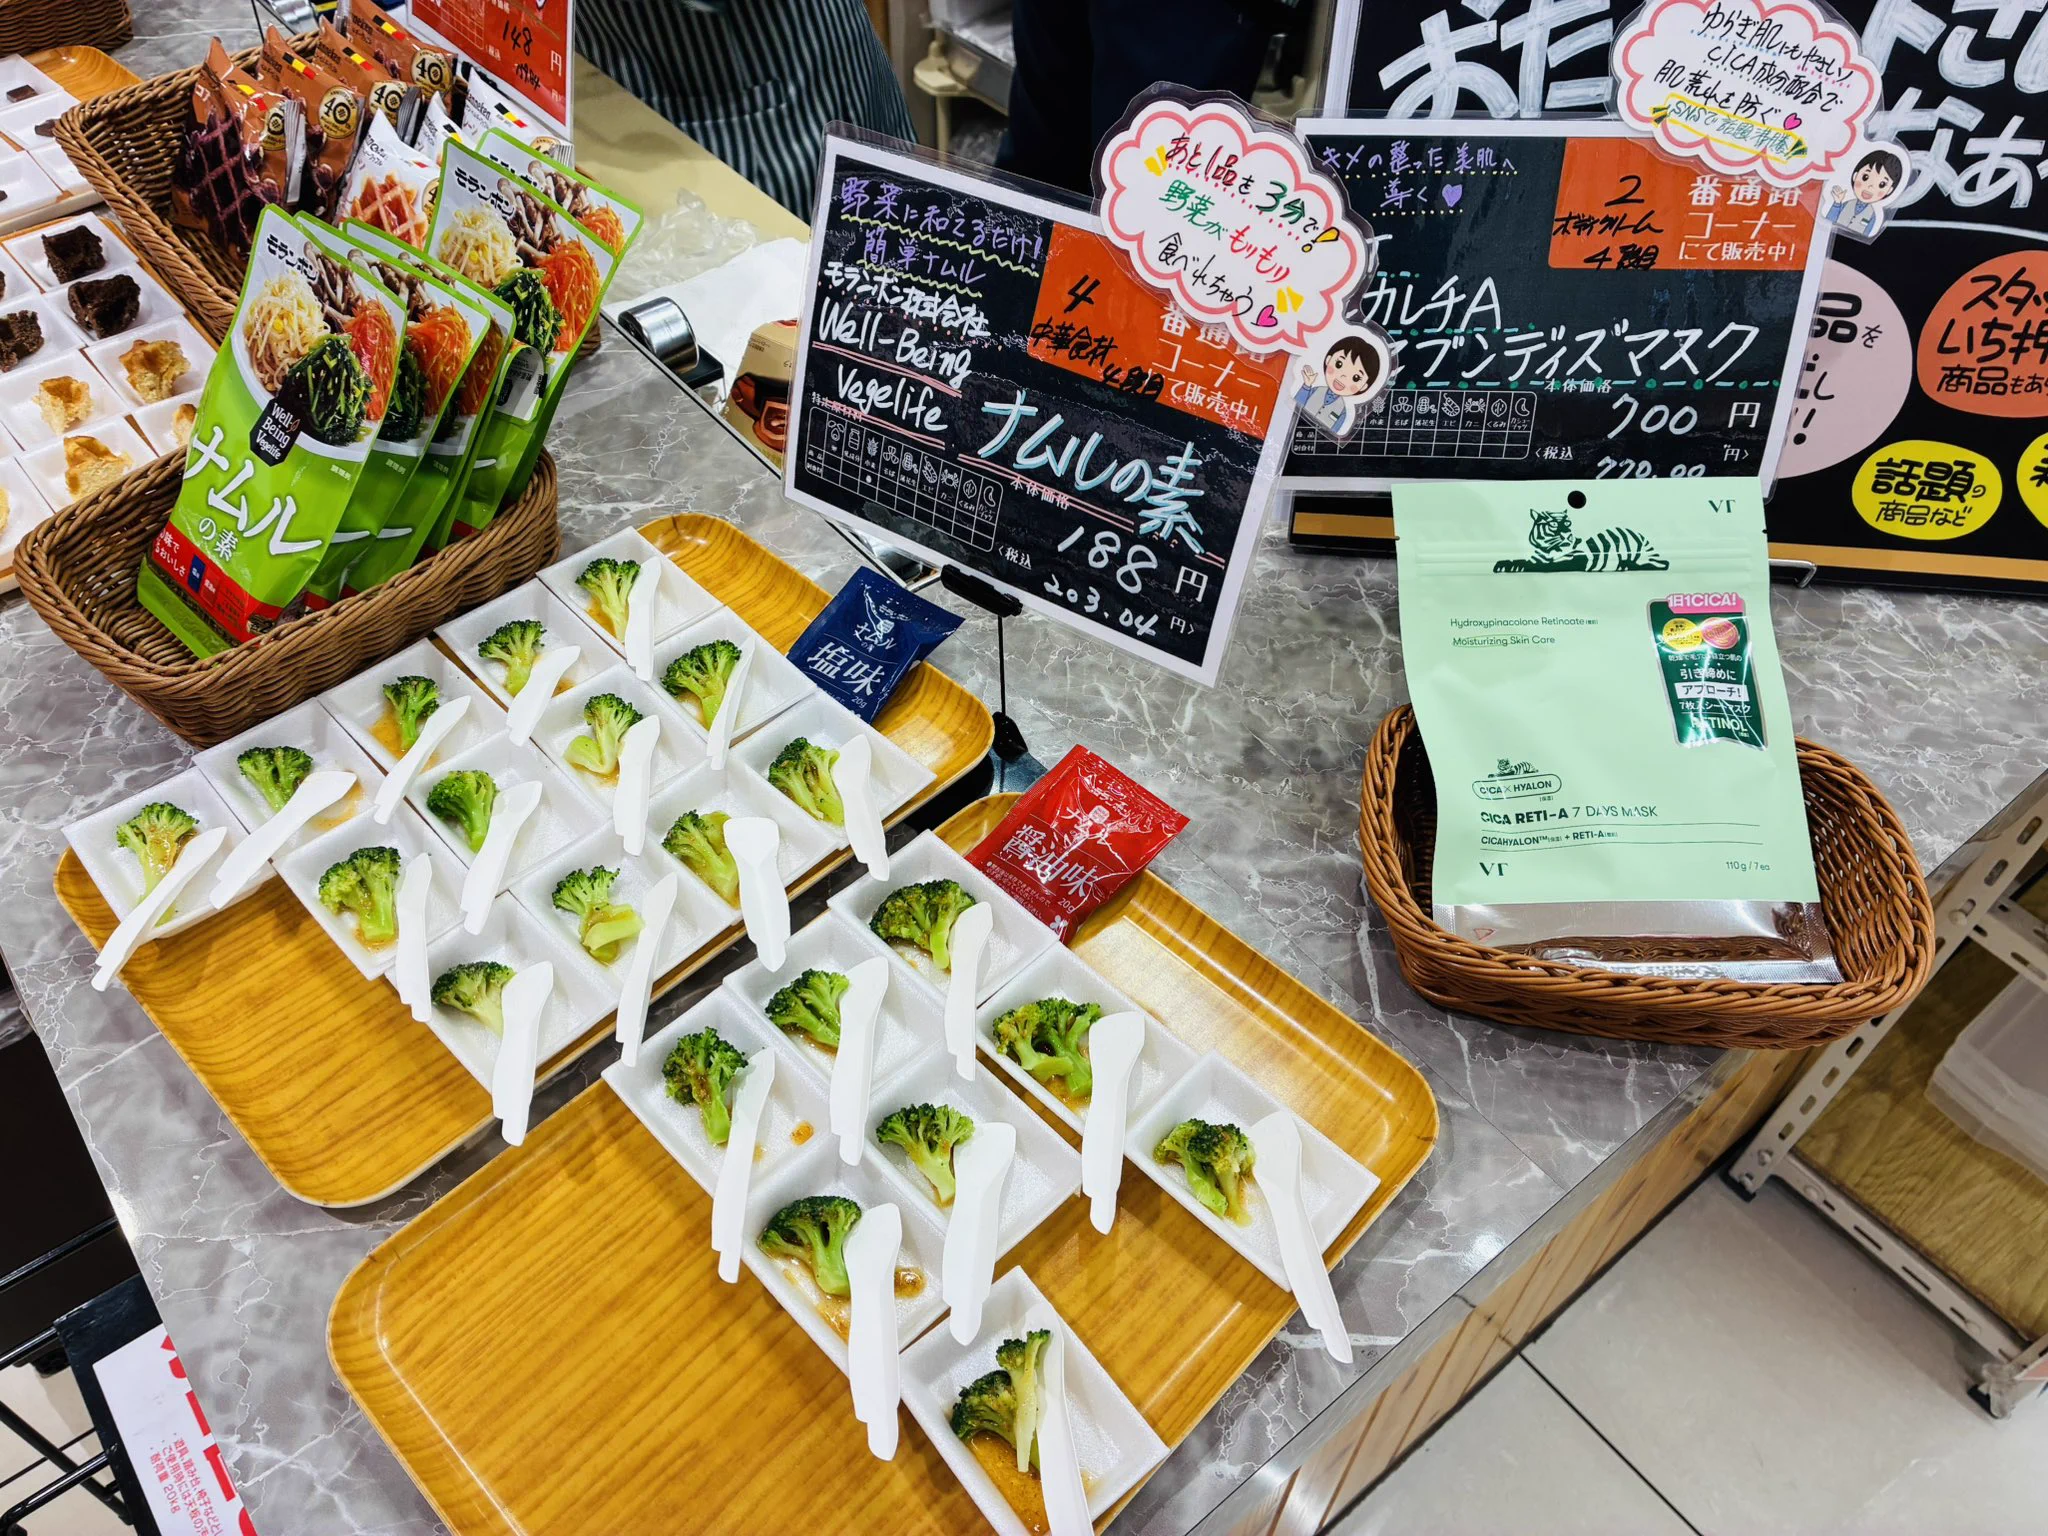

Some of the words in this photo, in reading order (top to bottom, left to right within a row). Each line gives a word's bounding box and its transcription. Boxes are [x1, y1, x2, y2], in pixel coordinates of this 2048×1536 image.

[503, 20, 533, 56] 148
[551, 50, 562, 77] 円
[1707, 44, 1843, 112] CICA成分配合で
[1654, 59, 1782, 125] 肌荒れを防ぐ
[1322, 140, 1515, 174] キメの整った美肌へ
[1380, 178, 1428, 208] 導く
[1605, 175, 1645, 207] 2
[841, 177, 1043, 269] 野菜に和えるだけ!
[1159, 179, 1290, 283] 野菜がもりもり
[1684, 211, 1796, 240] コーナー
[863, 227, 987, 284] 簡単ナムル
[1679, 241, 1795, 261] にて販売中!
[1158, 231, 1254, 316] 食べれちゃう
[1064, 275, 1100, 313] 4
[1346, 274, 1502, 331] カレチA
[818, 296, 974, 388] Well-Being
[1152, 337, 1261, 388] コーナー
[838, 364, 948, 431] Vegelife
[1544, 378, 1613, 394] 本体価格
[1607, 393, 1698, 439] 700
[1728, 402, 1761, 428] 円
[256, 429, 282, 460] Vegelife
[262, 416, 291, 449] Being
[977, 389, 1205, 554] ナムルの素
[1871, 457, 1986, 503] 話題の
[184, 425, 323, 556] ナムル
[1708, 500, 1736, 514] VT
[1875, 500, 1973, 527] 商品など
[198, 517, 239, 562] の素
[1057, 525, 1158, 594] 188
[1174, 565, 1208, 602] 円
[1044, 574, 1159, 636] 203.04
[1666, 592, 1737, 608] 1日1CICA!
[1450, 617, 1539, 629] Hydroxypinacolone
[1541, 617, 1585, 625] Retinoate
[1453, 637, 1508, 647] Moisturizing
[1510, 635, 1529, 645] Skin
[1532, 635, 1555, 644] Care
[806, 641, 885, 696] 塩味
[1668, 653, 1742, 662] 乾燥で毛穴目立つ肌の
[1680, 668, 1737, 681] 引き締めに
[851, 696, 868, 709] 20g
[1682, 684, 1741, 698] アプローチ!
[1480, 786, 1503, 795] CICA
[1514, 780, 1552, 792] HYALON
[1481, 811, 1512, 825] CICA
[1515, 807, 1569, 824] RETI-A
[1572, 807, 1581, 818] 7
[1586, 805, 1619, 817] DAYS
[1621, 805, 1658, 817] MASK
[1573, 830, 1605, 840] RETI-A
[1479, 862, 1509, 877] VT
[1725, 861, 1747, 871] 110g
[1058, 898, 1075, 915] 20g
[164, 1484, 182, 1514] 20kg
